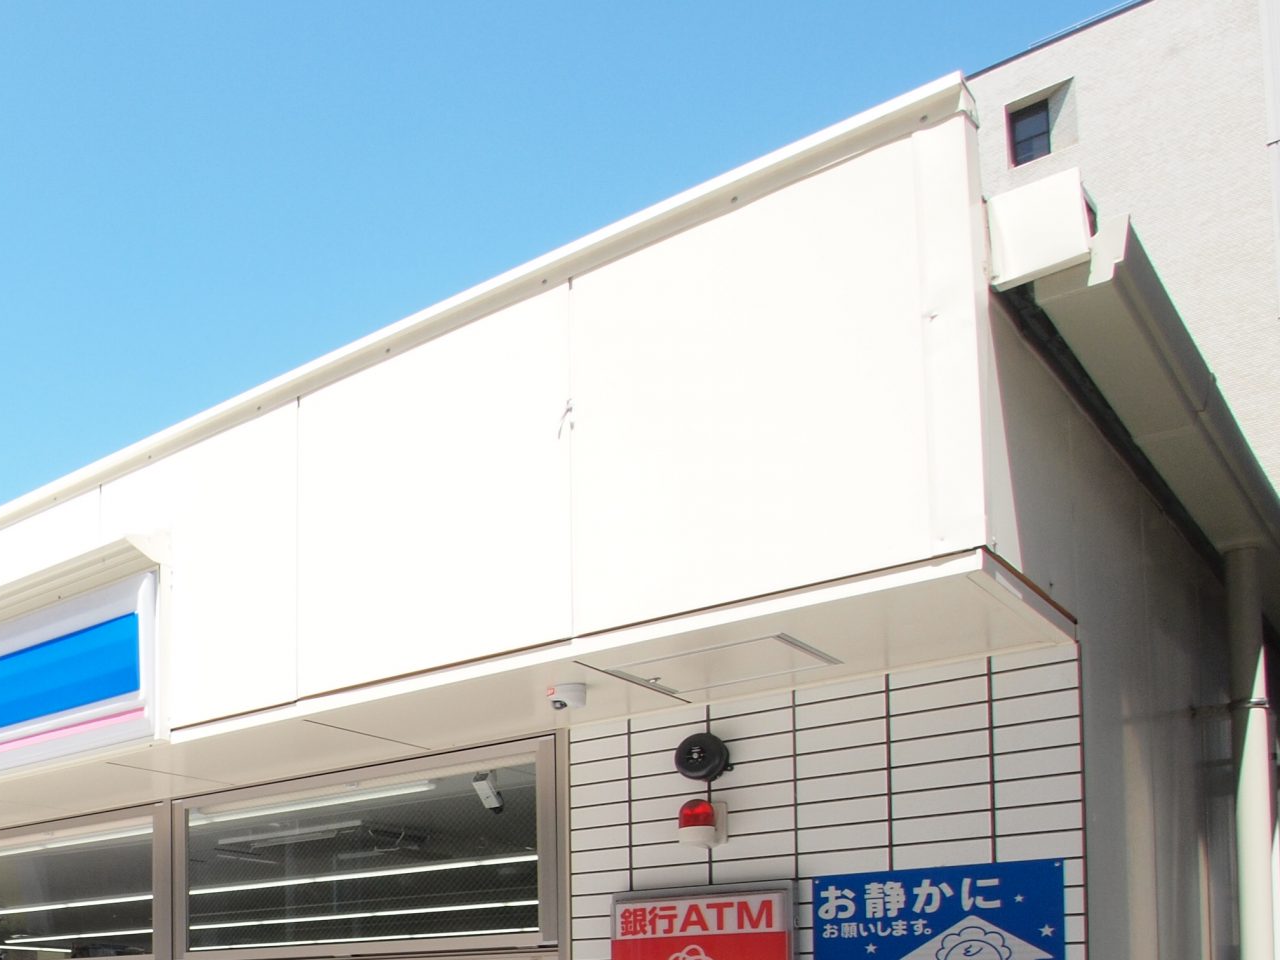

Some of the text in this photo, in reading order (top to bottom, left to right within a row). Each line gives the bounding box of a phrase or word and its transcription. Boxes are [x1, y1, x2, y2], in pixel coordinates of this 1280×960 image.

[818, 877, 1001, 920] お静かに
[620, 899, 773, 936] 銀行ATM
[822, 919, 932, 938] お願いします。
